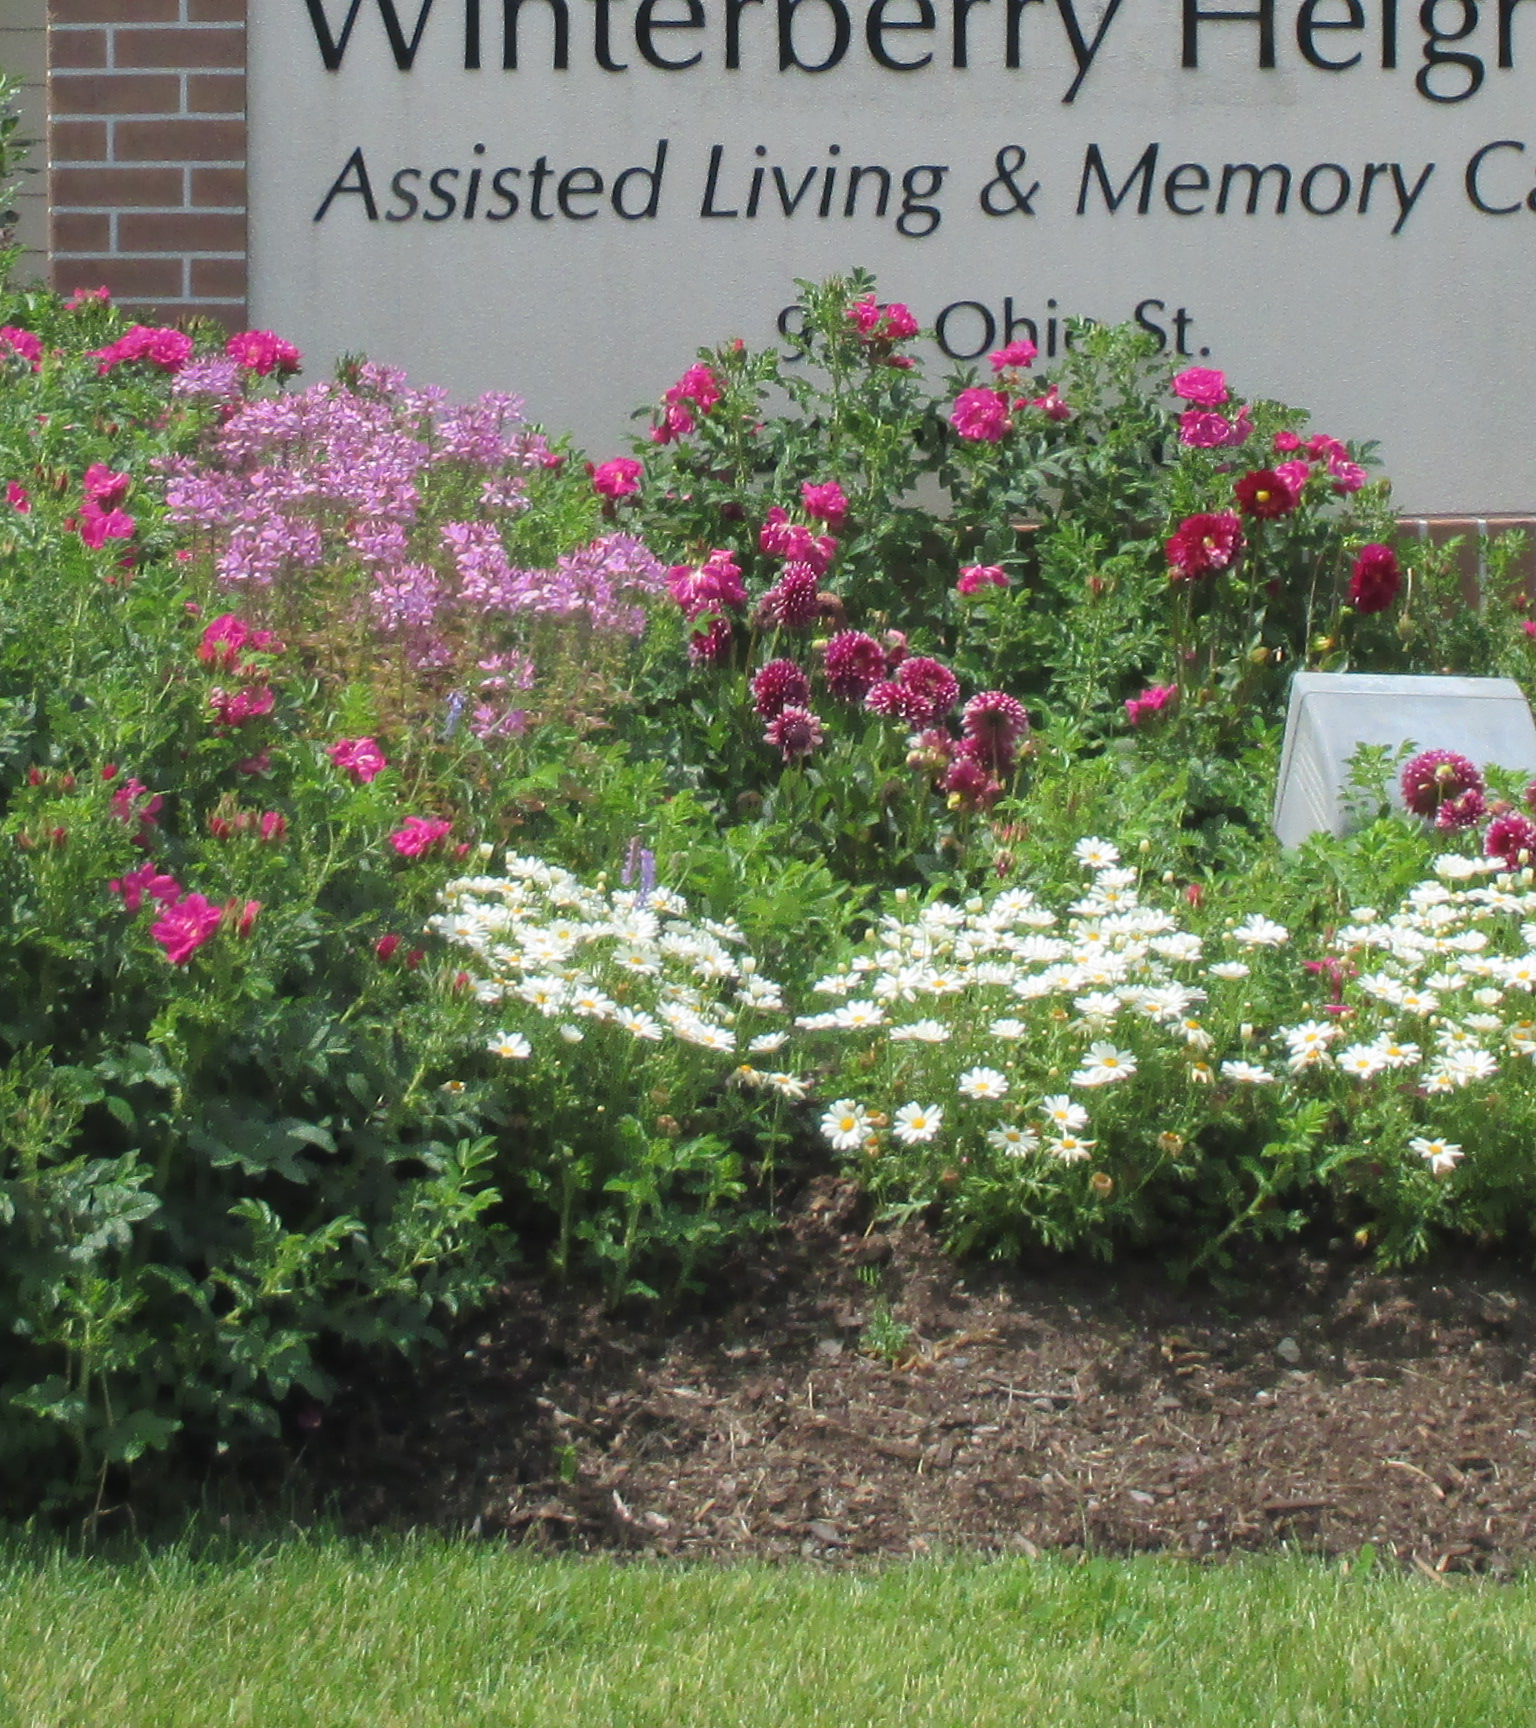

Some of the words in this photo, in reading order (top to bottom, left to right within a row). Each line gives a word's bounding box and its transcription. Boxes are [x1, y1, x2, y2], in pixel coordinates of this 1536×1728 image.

[312, 138, 669, 223] Assisted
[700, 144, 949, 239] Living
[979, 144, 1040, 218] &
[1076, 142, 1436, 236] Memory
[1135, 298, 1211, 362] St.
